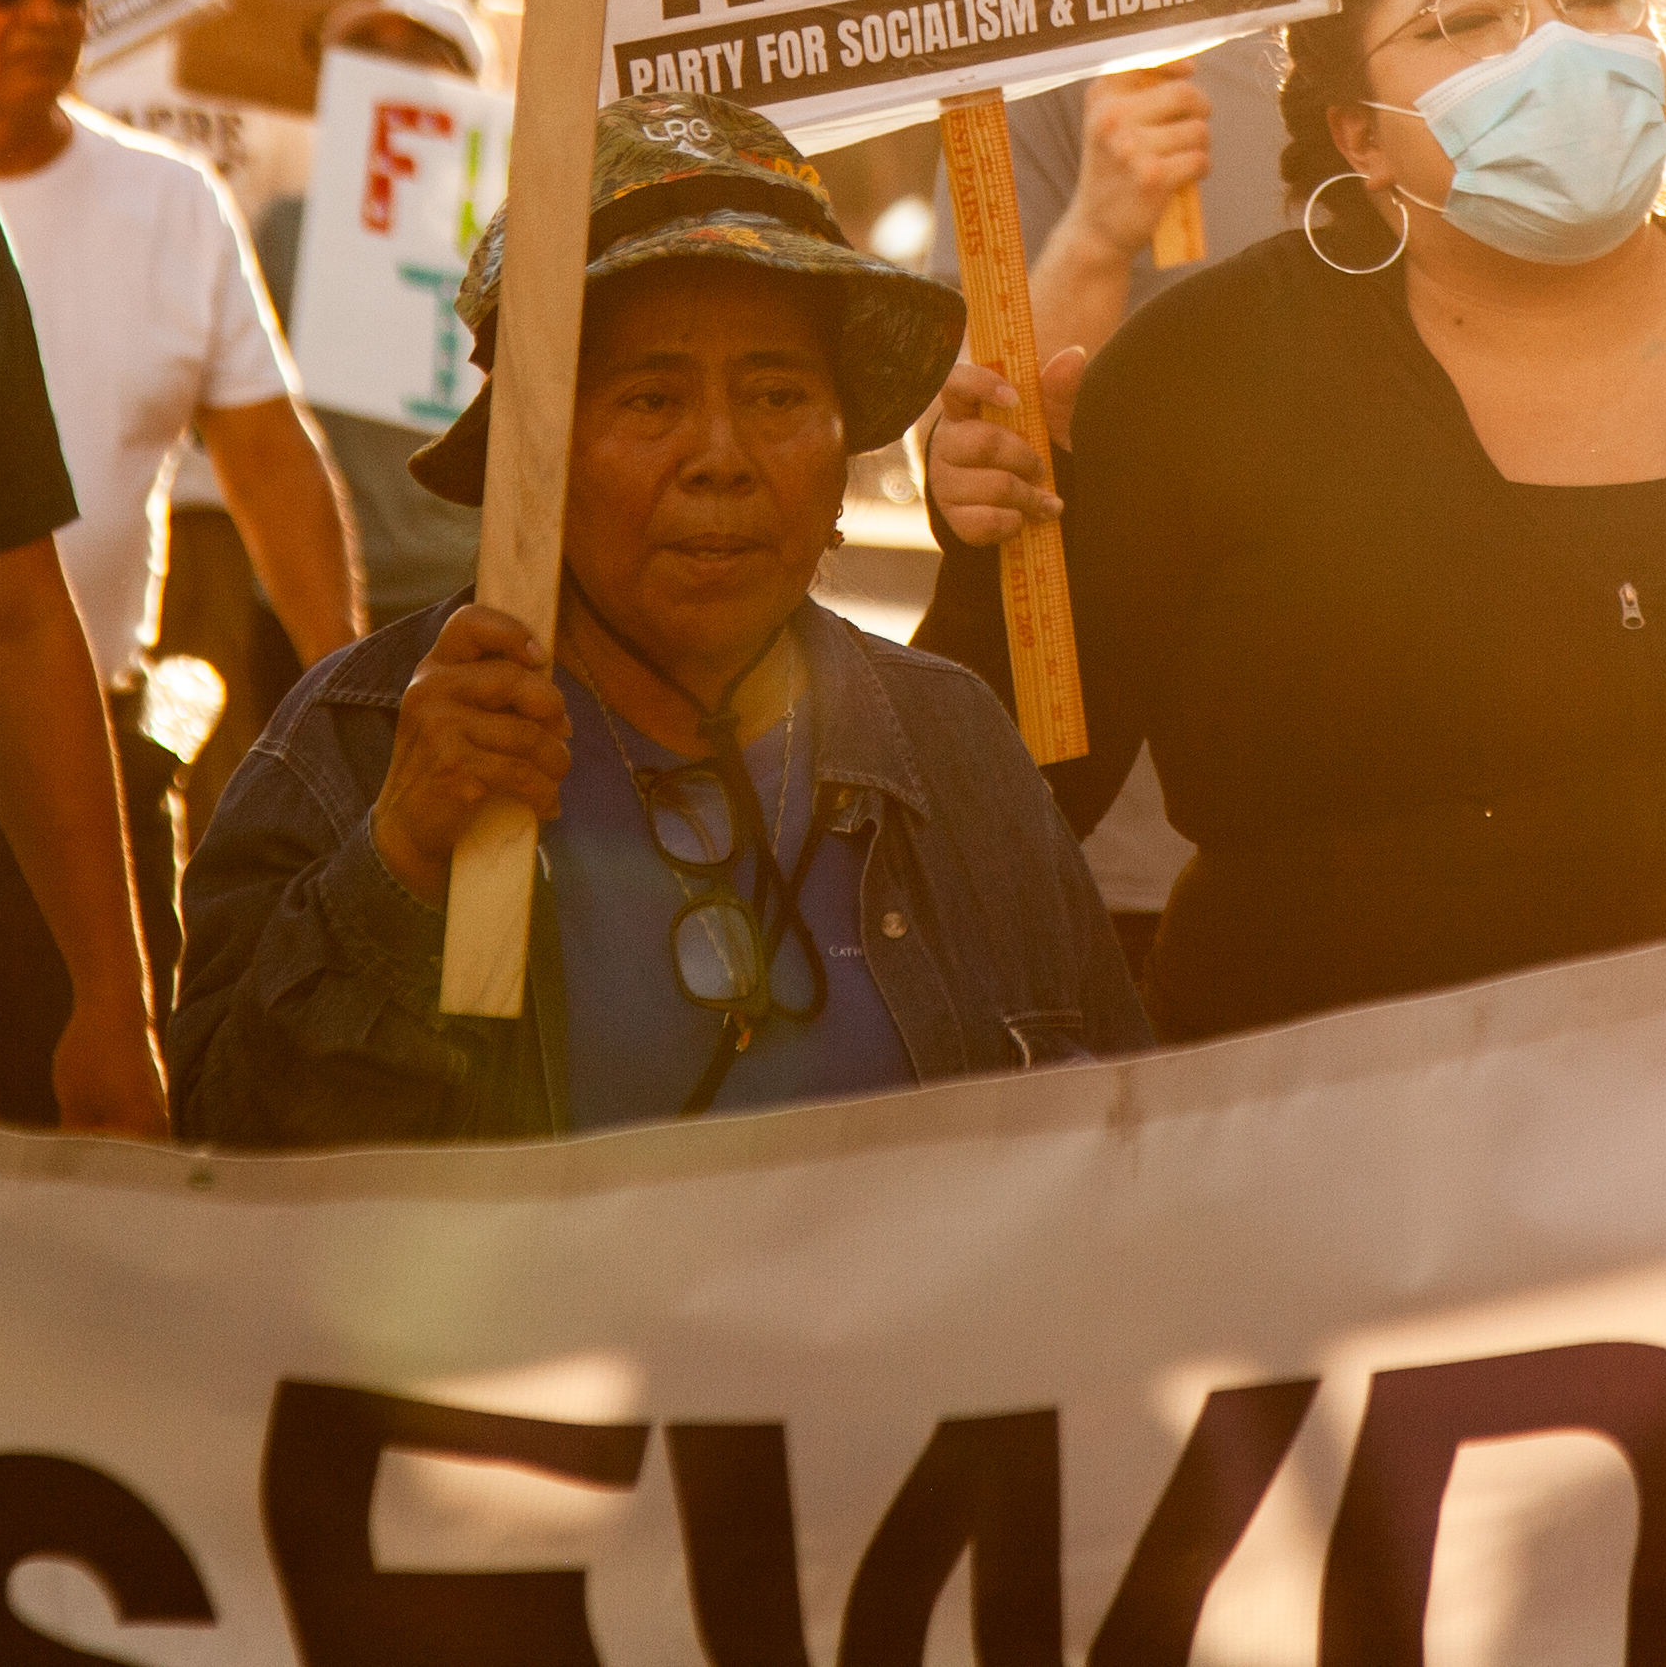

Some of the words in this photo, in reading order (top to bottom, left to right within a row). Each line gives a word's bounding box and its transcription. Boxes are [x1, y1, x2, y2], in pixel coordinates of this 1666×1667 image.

[627, 38, 746, 99] PARTY
[756, 29, 828, 83] FOR
[643, 119, 712, 142] LRG
